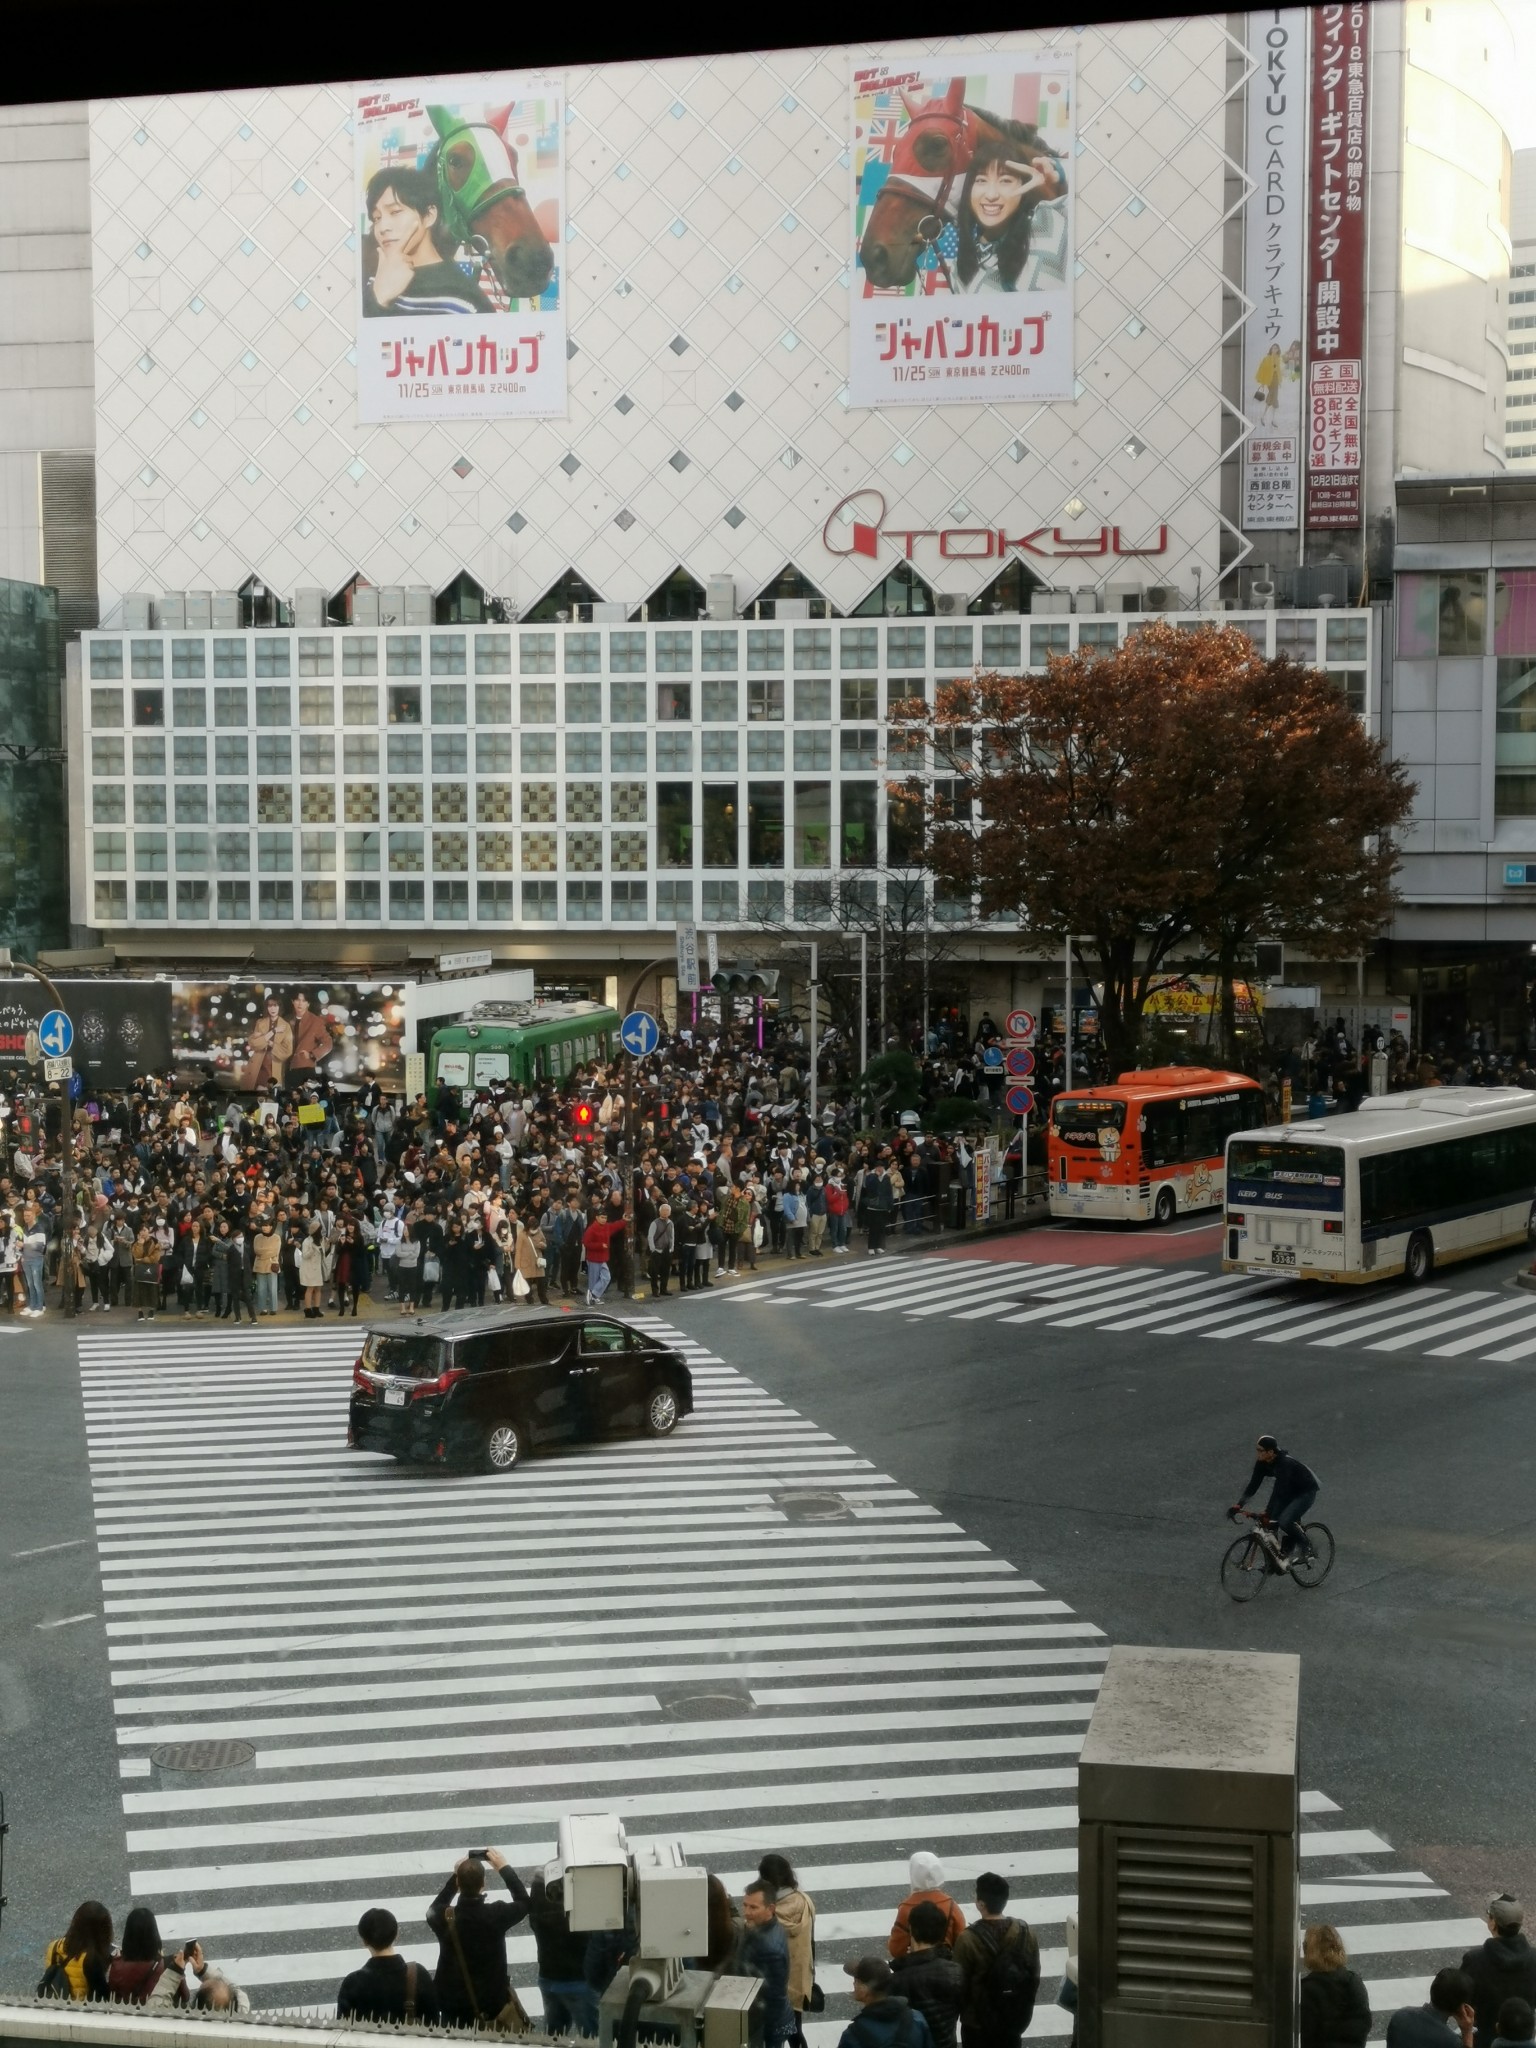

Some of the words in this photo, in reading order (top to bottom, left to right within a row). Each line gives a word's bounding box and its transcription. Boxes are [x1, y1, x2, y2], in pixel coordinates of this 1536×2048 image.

[1266, 125, 1286, 216] CARD
[1264, 222, 1286, 340] クラブキュウ
[875, 311, 1052, 360] ジャパンカップ
[381, 331, 546, 378] ジャパンカップ
[893, 365, 926, 382] 11/25
[946, 365, 986, 378] 東京競馬場
[991, 364, 1030, 377] 芝2400m
[1319, 364, 1354, 379] 全国
[398, 382, 430, 398] 11/25
[448, 383, 486, 394] 東京競馬場
[490, 382, 526, 394] 芝2400m
[1314, 382, 1358, 394] 無料配送
[1311, 398, 1327, 467] 800選
[1329, 397, 1342, 466] 配送ギフト
[1344, 396, 1358, 466] 全国無料
[1252, 440, 1292, 451] 新規会員
[1252, 452, 1292, 462] 募集中
[1250, 480, 1292, 490] 西館8階
[1247, 493, 1294, 502] カスタマー
[1247, 502, 1293, 511] センターへ
[882, 524, 1168, 560] TOKYU
[685, 928, 696, 986] 渋谷駅前
[1238, 1190, 1258, 1198] KEIO
[1265, 1192, 1284, 1200] BUS
